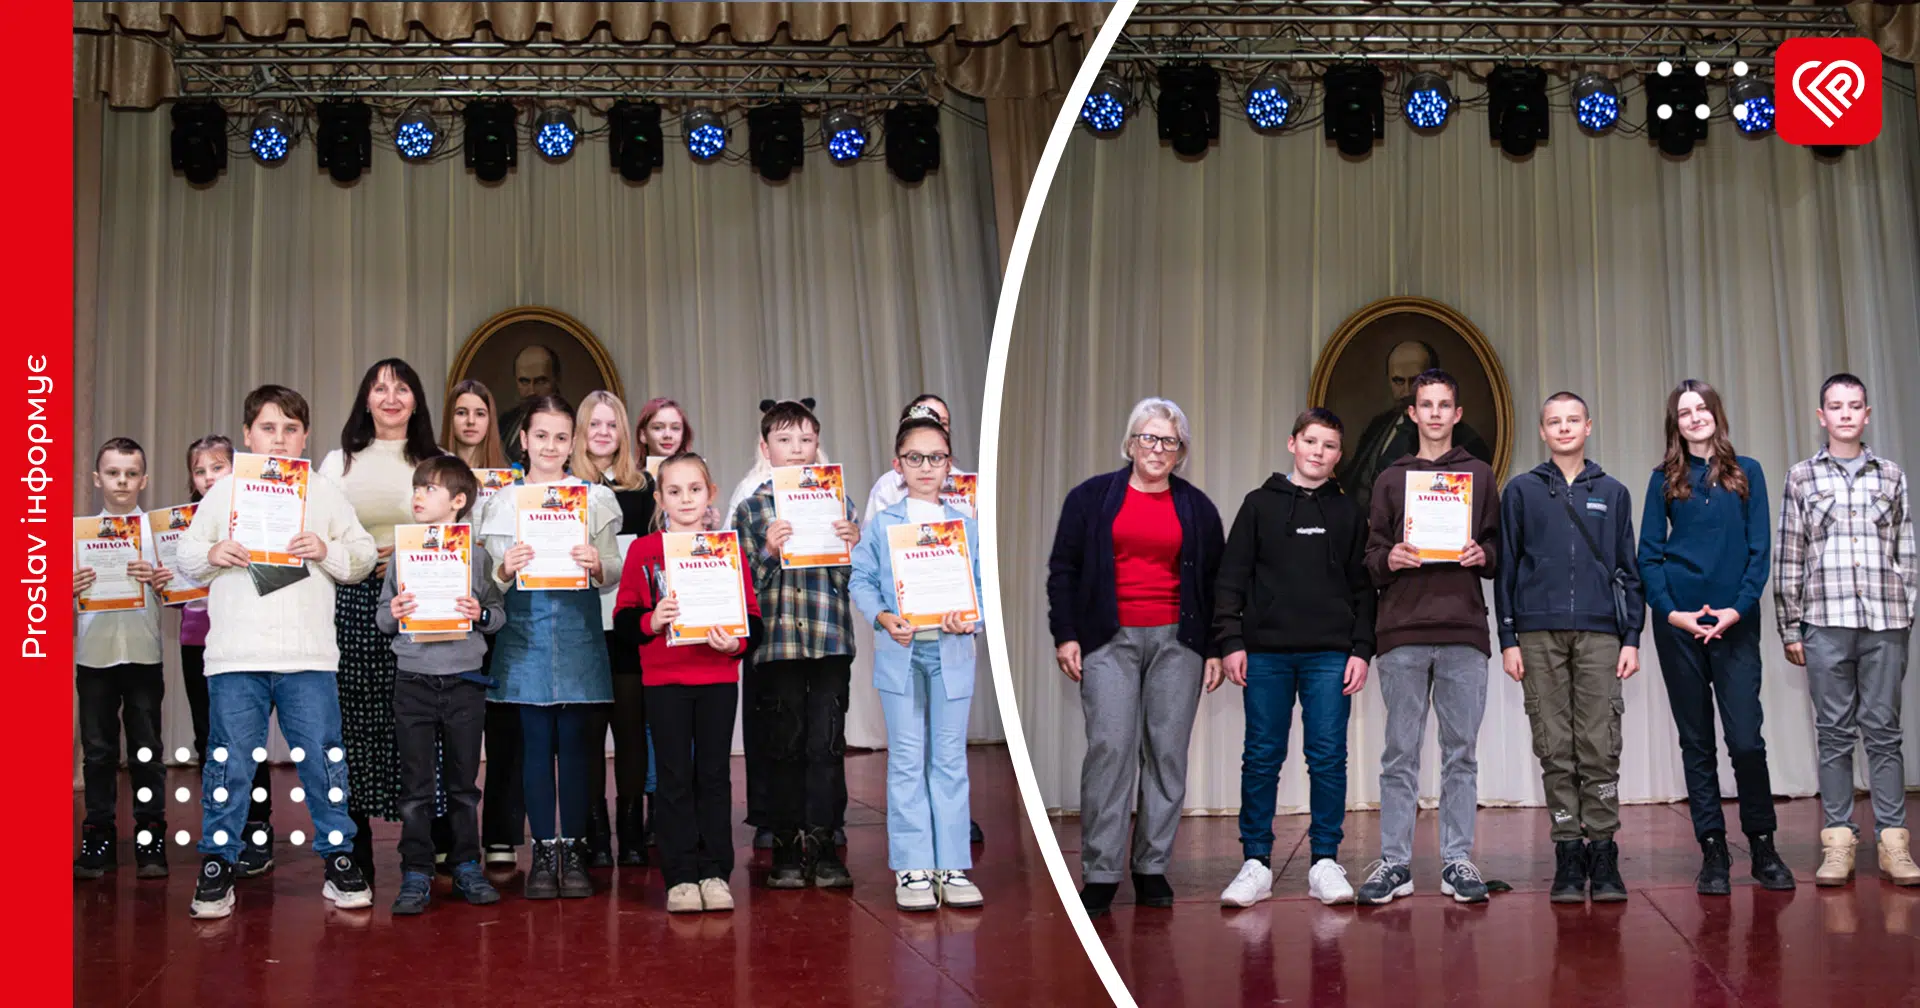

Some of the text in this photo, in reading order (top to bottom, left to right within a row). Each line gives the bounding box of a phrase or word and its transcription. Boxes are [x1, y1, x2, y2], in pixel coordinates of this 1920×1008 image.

[243, 484, 295, 496] ДИПЛОМ
[786, 492, 833, 501] ДИПЛОМ
[528, 513, 576, 521] ДИПЛОМ
[84, 541, 131, 550] ДИПЛОМ
[904, 549, 955, 560] ДИПЛОМ
[678, 560, 728, 569] ДИПЛОМ
